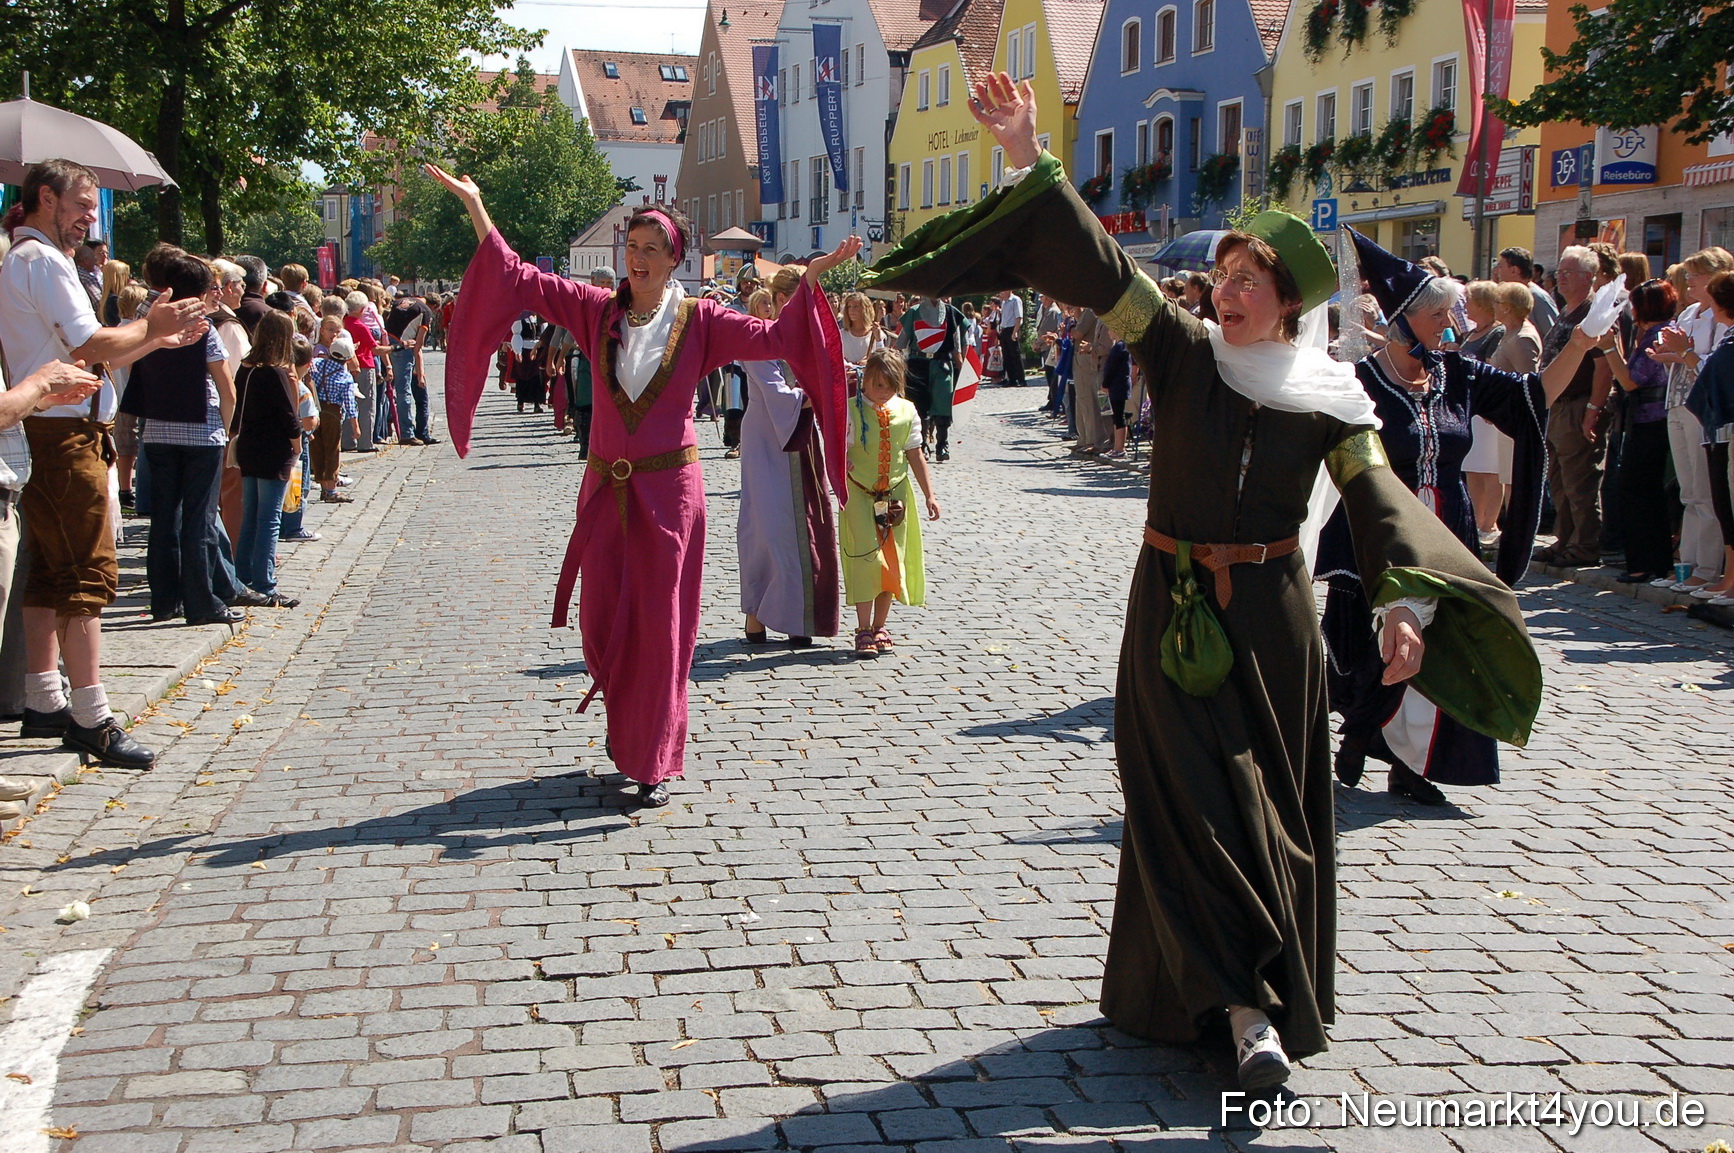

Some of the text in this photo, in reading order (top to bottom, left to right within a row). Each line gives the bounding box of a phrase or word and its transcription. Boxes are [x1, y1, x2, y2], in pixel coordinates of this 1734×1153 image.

[827, 88, 843, 171] K&L RUPPERT
[928, 130, 949, 152] HOTEL
[1247, 145, 1259, 198] WITT
[1522, 149, 1532, 209] KINO
[1603, 170, 1652, 180] Reisebüro
[1317, 203, 1332, 228] P
